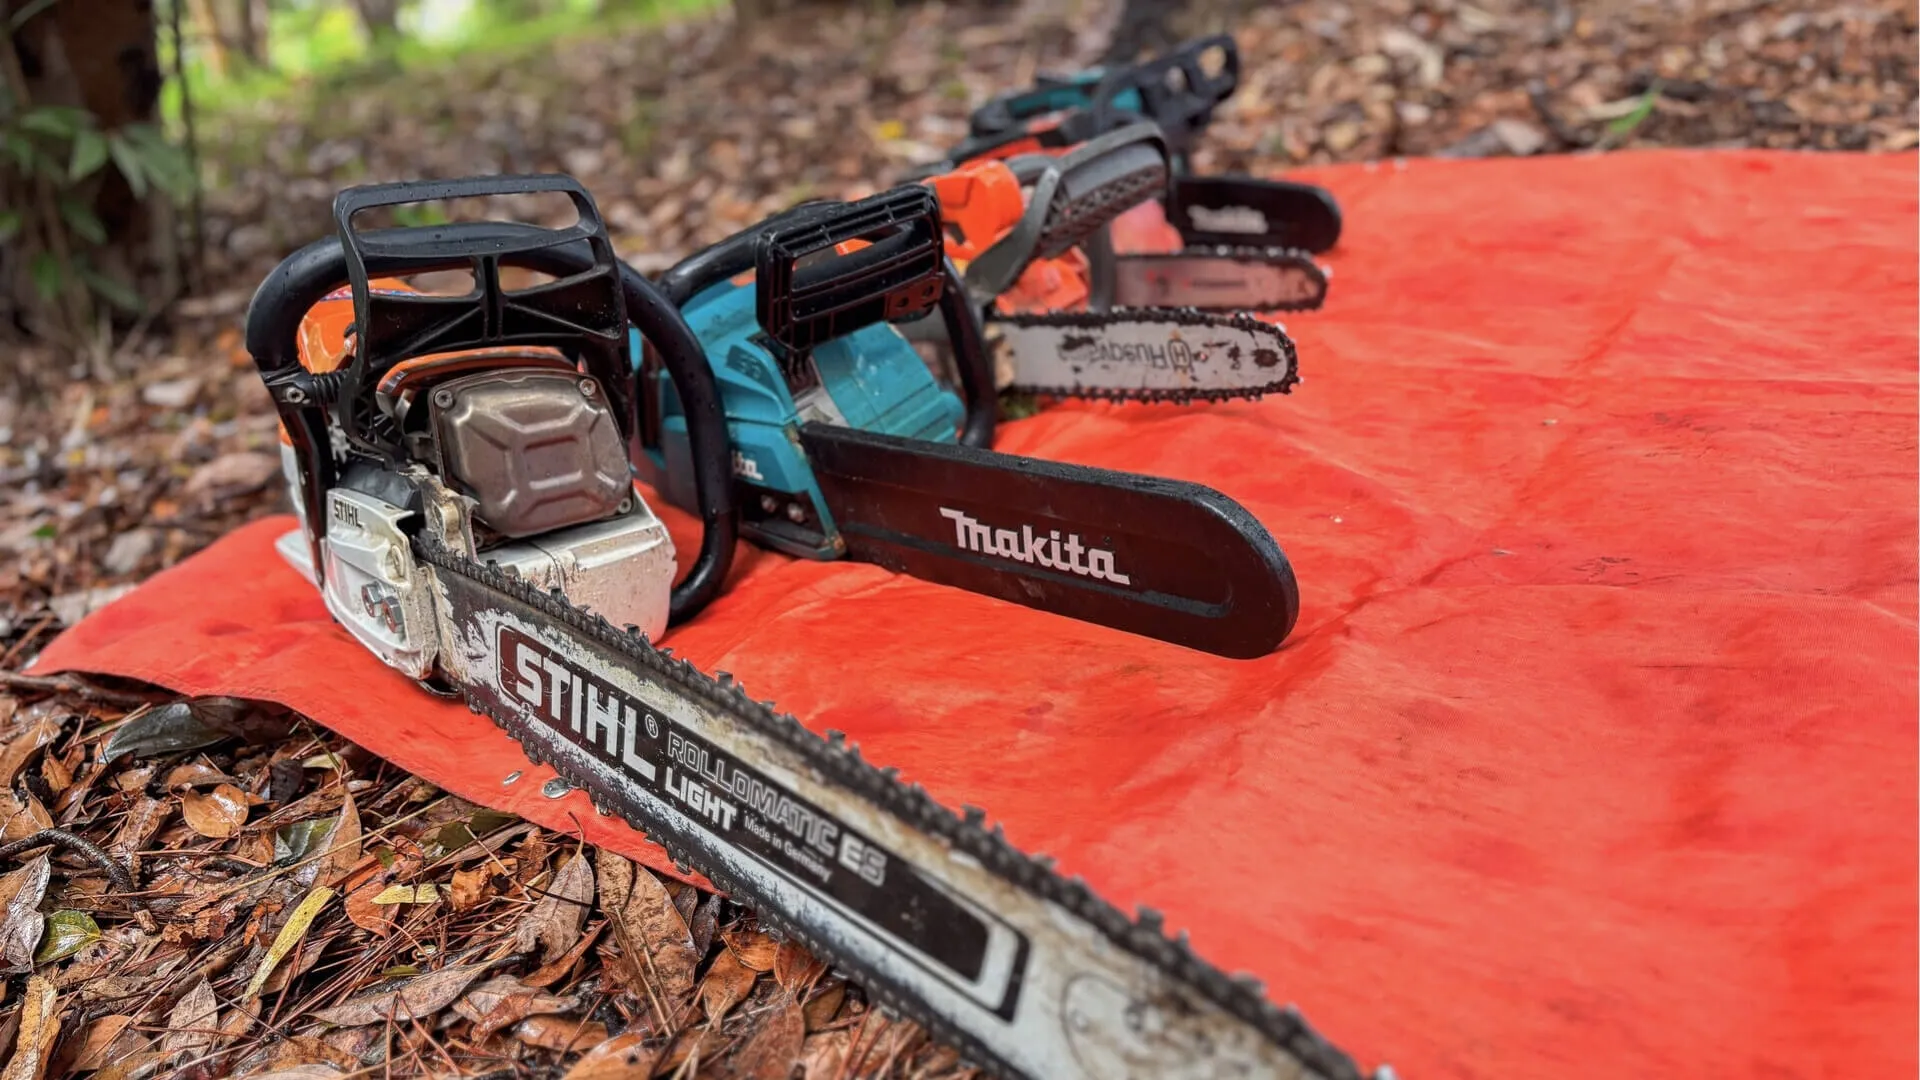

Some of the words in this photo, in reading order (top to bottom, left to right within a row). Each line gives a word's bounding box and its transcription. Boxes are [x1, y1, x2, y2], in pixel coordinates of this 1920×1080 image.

[1057, 342, 1168, 369] Husqva
[334, 499, 362, 528] STIHL
[665, 767, 737, 831] LIGHT
[668, 731, 838, 858] ROLLOMATIC
[838, 832, 887, 887] ES
[744, 815, 770, 843] Made
[772, 832, 783, 849] in
[784, 841, 833, 883] Germany
